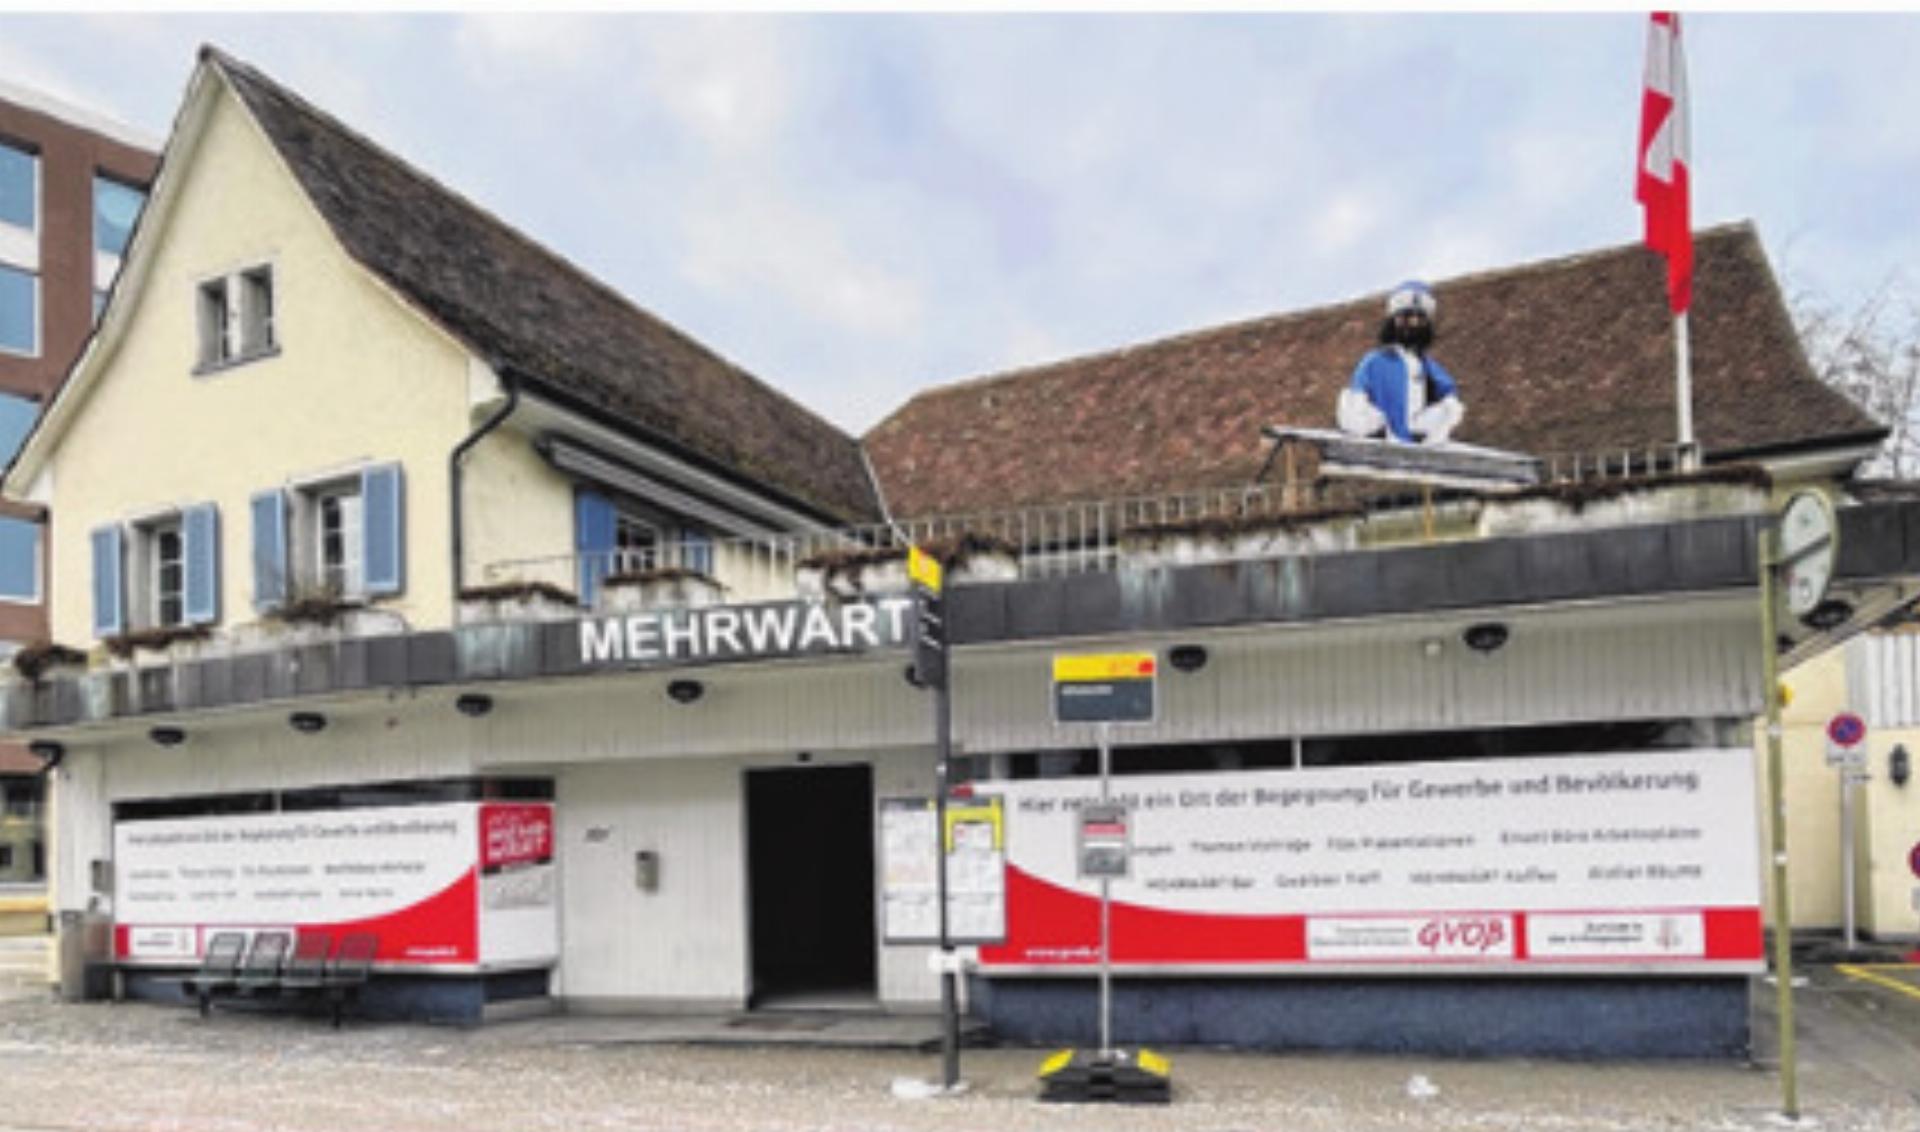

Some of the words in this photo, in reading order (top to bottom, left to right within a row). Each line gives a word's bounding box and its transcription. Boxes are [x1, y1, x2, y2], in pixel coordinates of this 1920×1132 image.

[579, 594, 912, 664] MEHRWÄRT
[1144, 788, 1174, 807] ein
[1215, 787, 1249, 808] der
[1254, 786, 1368, 808] Begegnung
[1372, 778, 1400, 799] für
[1408, 776, 1502, 799] Gewerbe
[1507, 774, 1549, 795] und
[1555, 769, 1698, 794] Bevölkerung
